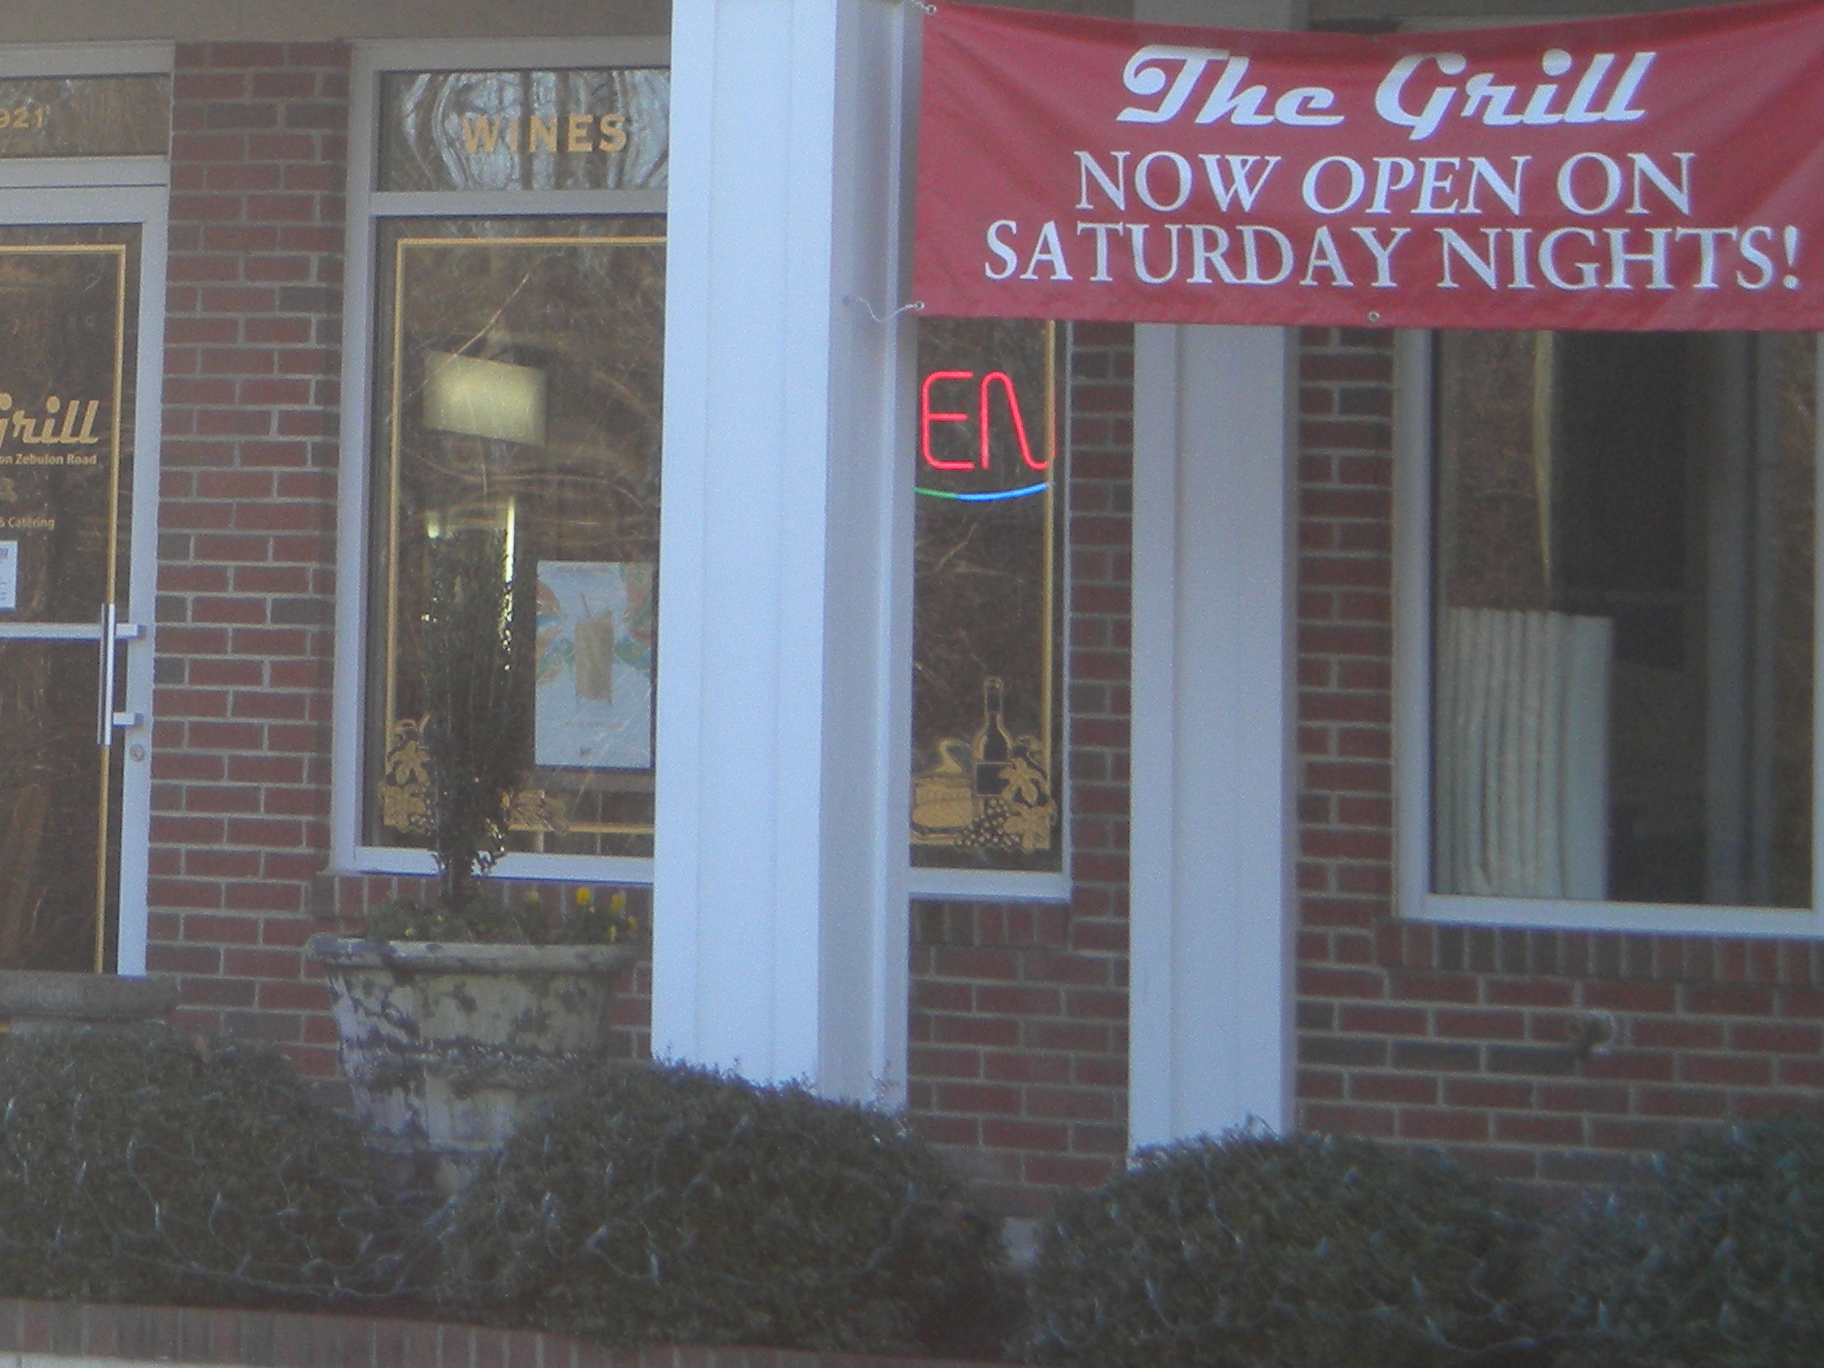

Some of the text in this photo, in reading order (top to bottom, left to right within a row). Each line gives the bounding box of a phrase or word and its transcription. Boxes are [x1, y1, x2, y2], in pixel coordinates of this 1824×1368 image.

[1115, 43, 1658, 141] The Grill
[460, 112, 631, 156] WINES
[1073, 150, 1696, 217] NOW OPEN ON
[983, 219, 1802, 292] SATURDAY NIGHTS!
[14, 453, 64, 466] Zebulon
[66, 453, 98, 466] Road
[8, 516, 56, 531] Catering
